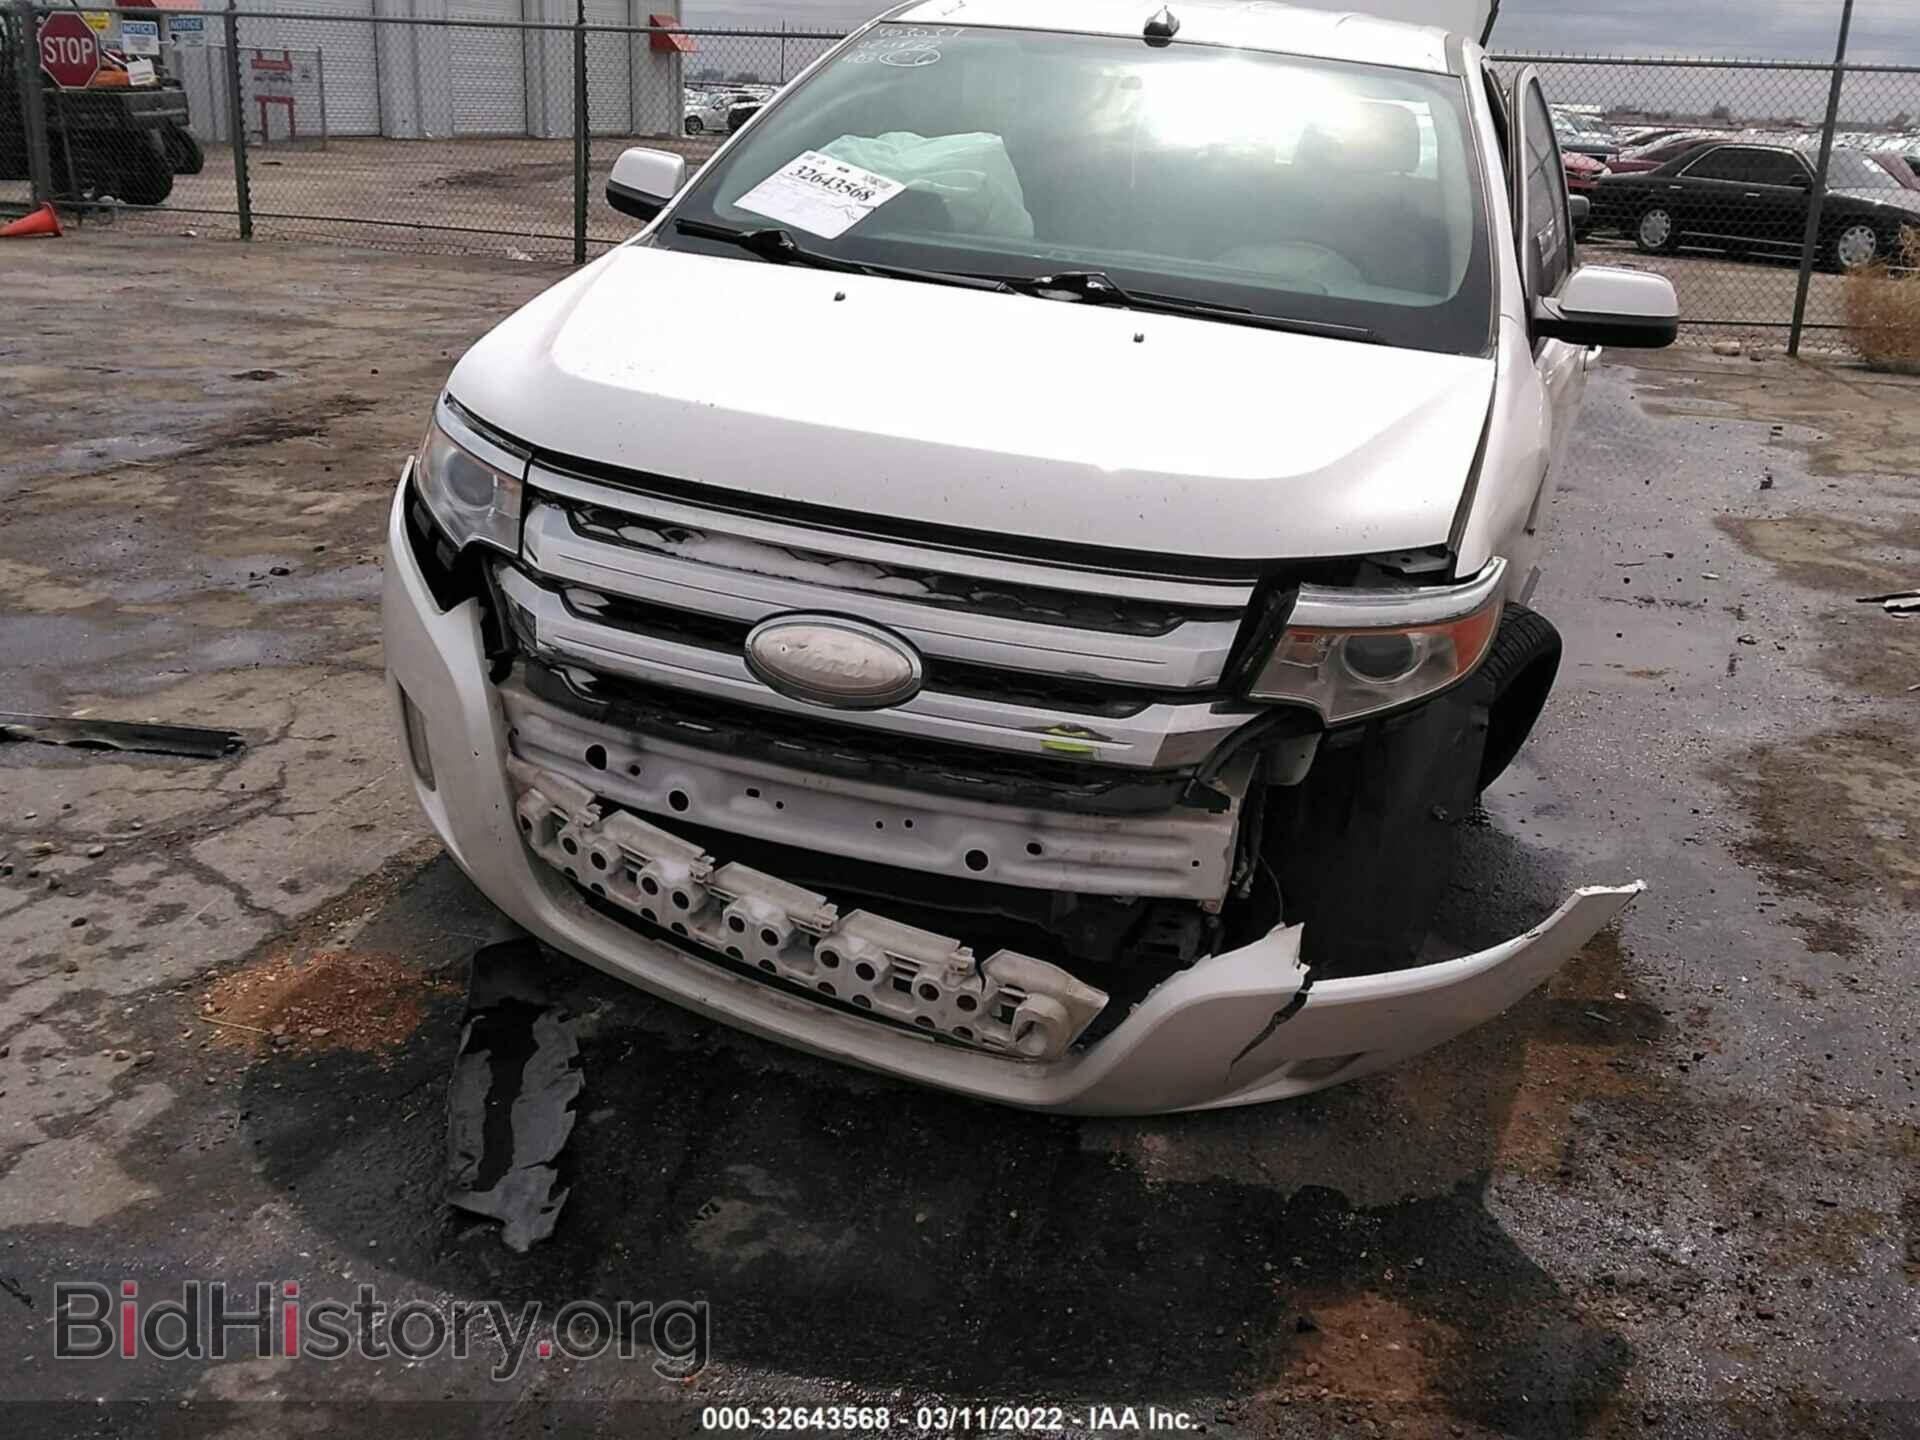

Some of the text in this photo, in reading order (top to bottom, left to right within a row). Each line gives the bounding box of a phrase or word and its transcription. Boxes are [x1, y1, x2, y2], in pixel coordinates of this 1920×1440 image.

[123, 23, 156, 36] NOTICE
[170, 18, 202, 30] NOTICE
[44, 37, 94, 65] STOP
[789, 165, 876, 202] 32643568
